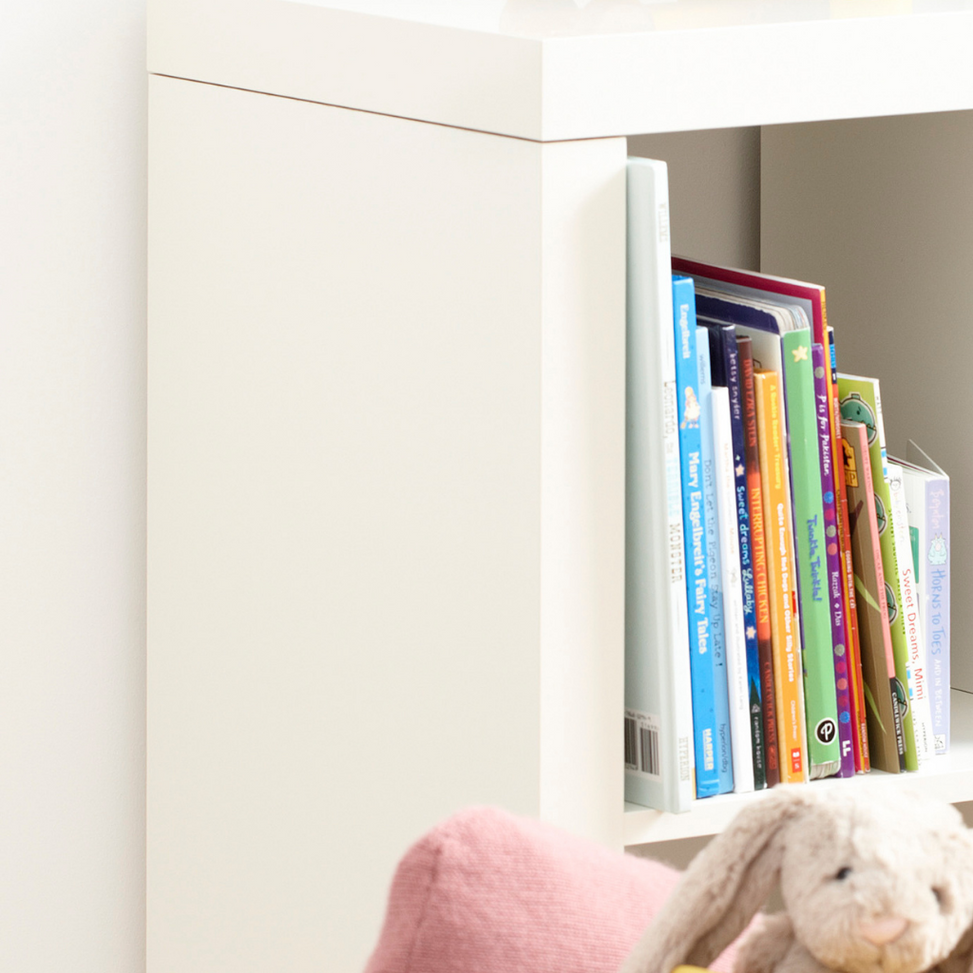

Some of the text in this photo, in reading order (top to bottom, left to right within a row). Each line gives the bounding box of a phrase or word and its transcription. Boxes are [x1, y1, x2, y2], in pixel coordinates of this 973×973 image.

[680, 303, 691, 359] Engelbreit
[730, 352, 740, 420] betsy snyder
[663, 380, 677, 438] Leonardo,
[817, 394, 831, 477] P is for Pakistan
[704, 459, 714, 489] Don't
[706, 492, 716, 512] Let
[707, 516, 716, 536] the
[779, 527, 787, 555] Enough
[669, 523, 683, 584] MONSTER
[688, 451, 709, 655] Mary Engelbreit's Fairy Tales
[706, 541, 718, 580] Pigeon
[737, 485, 755, 615] Sweet dreams Lullaby
[751, 487, 769, 623] INTERRUPTING CHICKEN
[710, 583, 721, 610] Stay
[810, 556, 822, 601] Twinkle!
[831, 571, 841, 599] Razzak
[931, 569, 946, 609] HORNS
[712, 613, 722, 629] Up
[784, 611, 792, 633] Other
[902, 568, 926, 700] Sweet Dreams, Mimi
[931, 626, 946, 655] TOES
[785, 635, 794, 653] Silly
[787, 653, 795, 682] Stories
[933, 659, 943, 727] AND IN BETWEEN
[753, 716, 762, 743] random
[768, 718, 776, 743] PRESS
[892, 692, 902, 735] CANDLEWICK
[679, 736, 690, 782] HYPERION
[702, 728, 714, 771] HARPER
